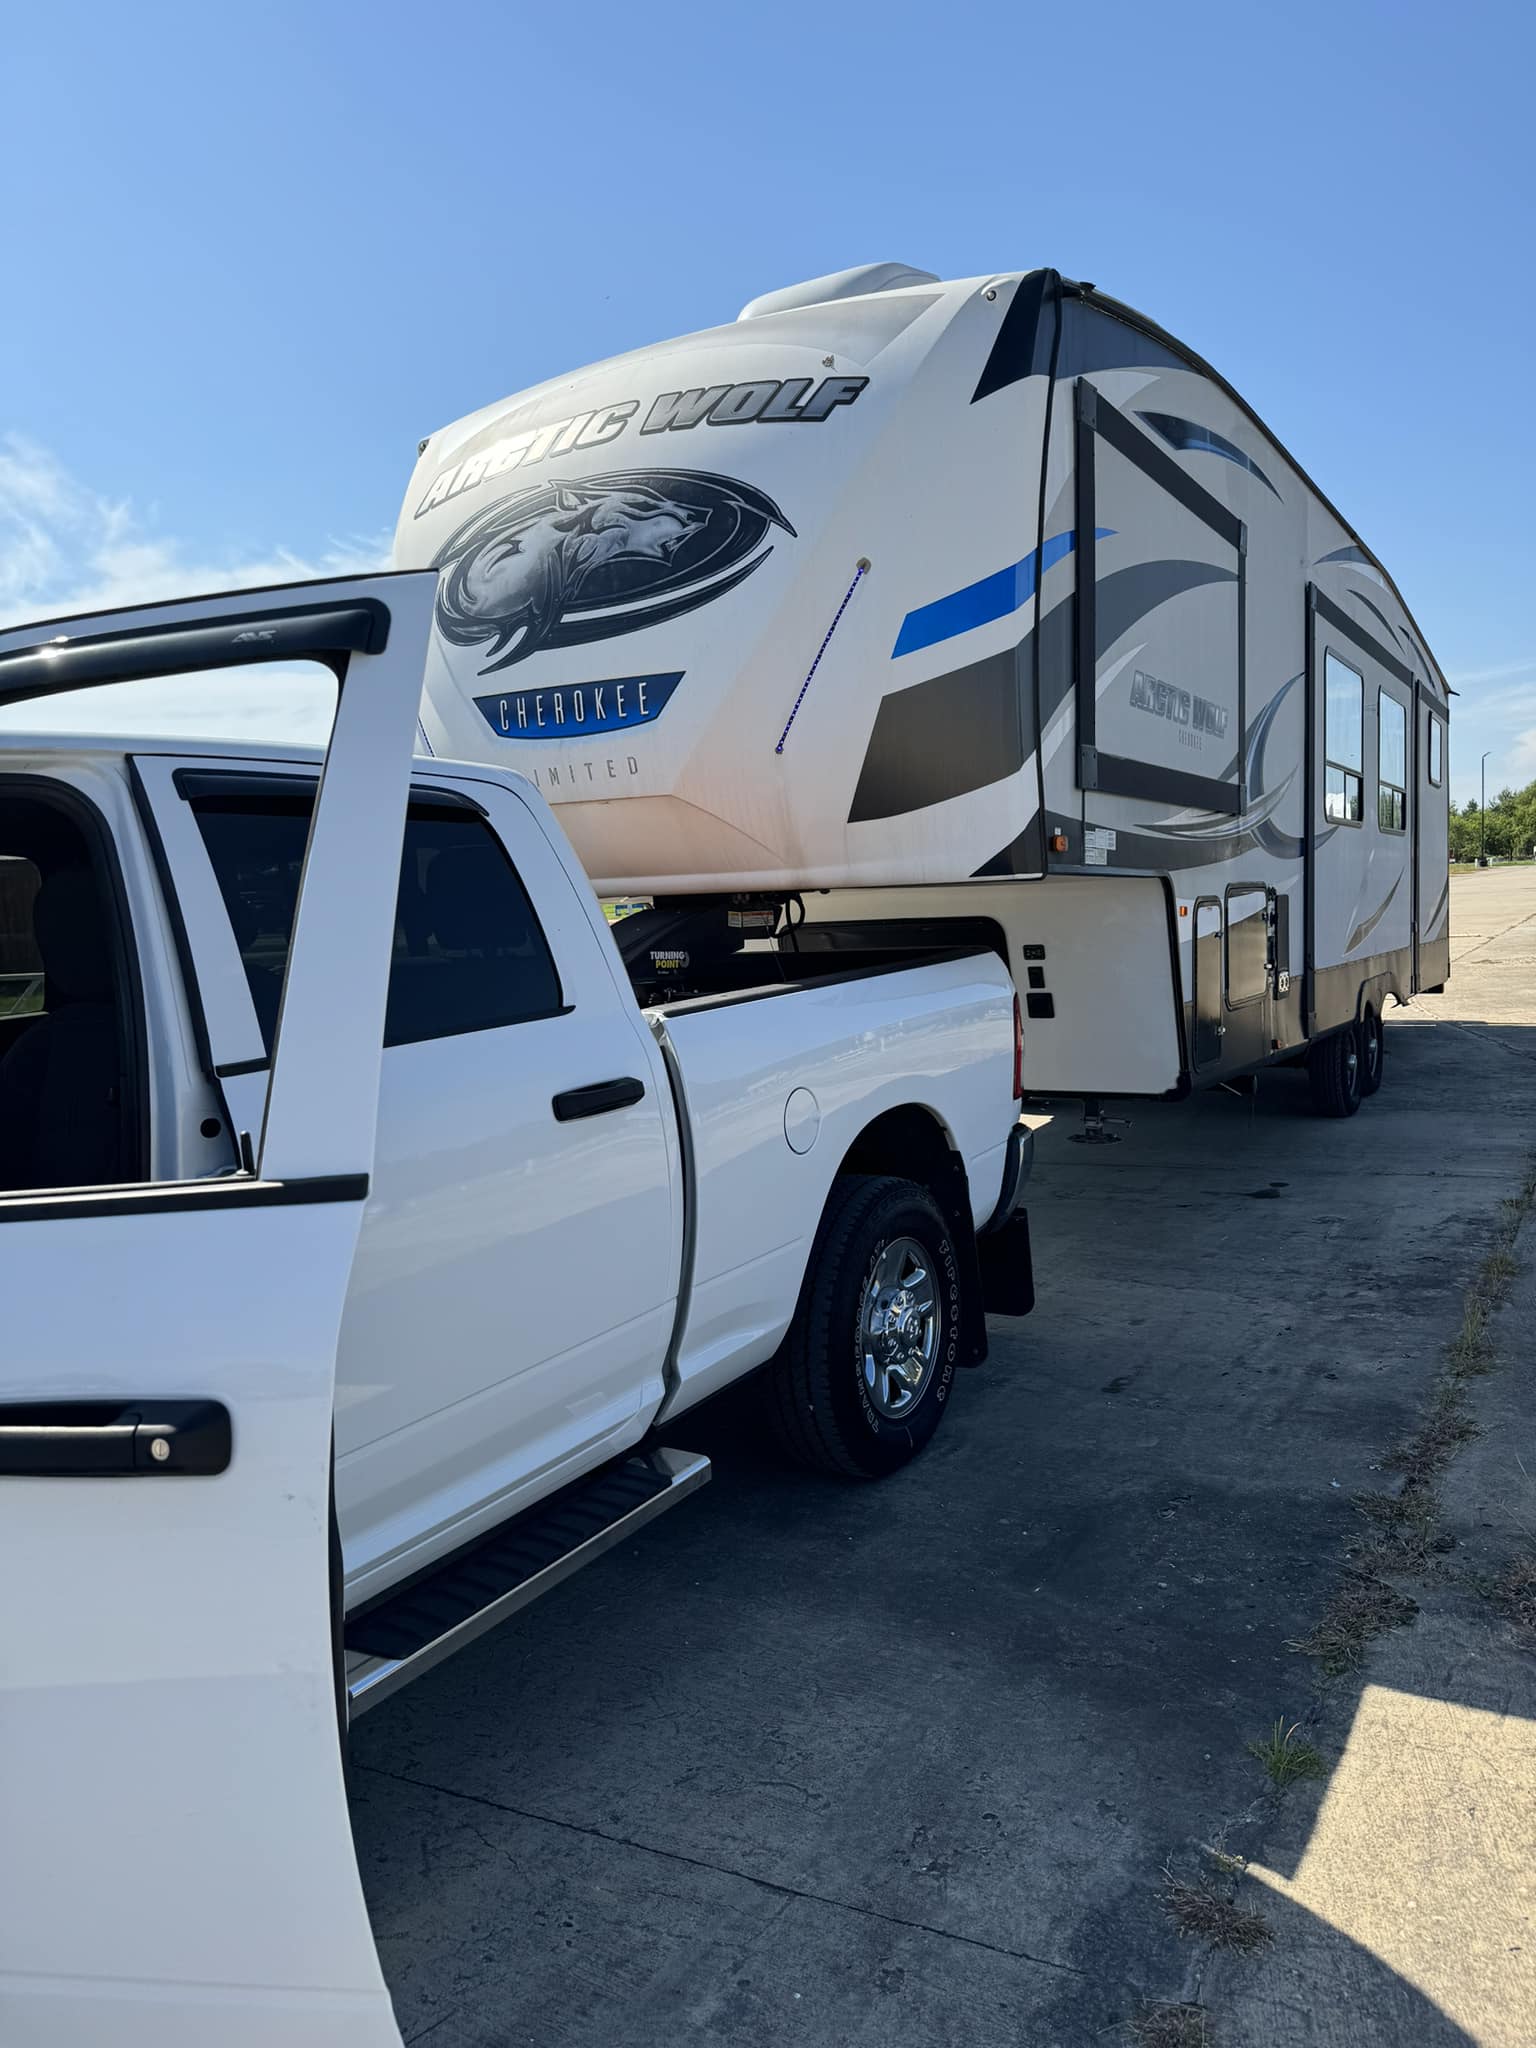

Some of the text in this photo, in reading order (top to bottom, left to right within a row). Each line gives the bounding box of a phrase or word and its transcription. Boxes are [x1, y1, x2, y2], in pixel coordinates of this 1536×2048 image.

[414, 376, 870, 520] ARCTIC WOLF
[500, 682, 649, 731] CHEROKEE
[533, 756, 639, 787] IMITED
[650, 951, 685, 960] TURNING
[655, 960, 679, 969] POINT
